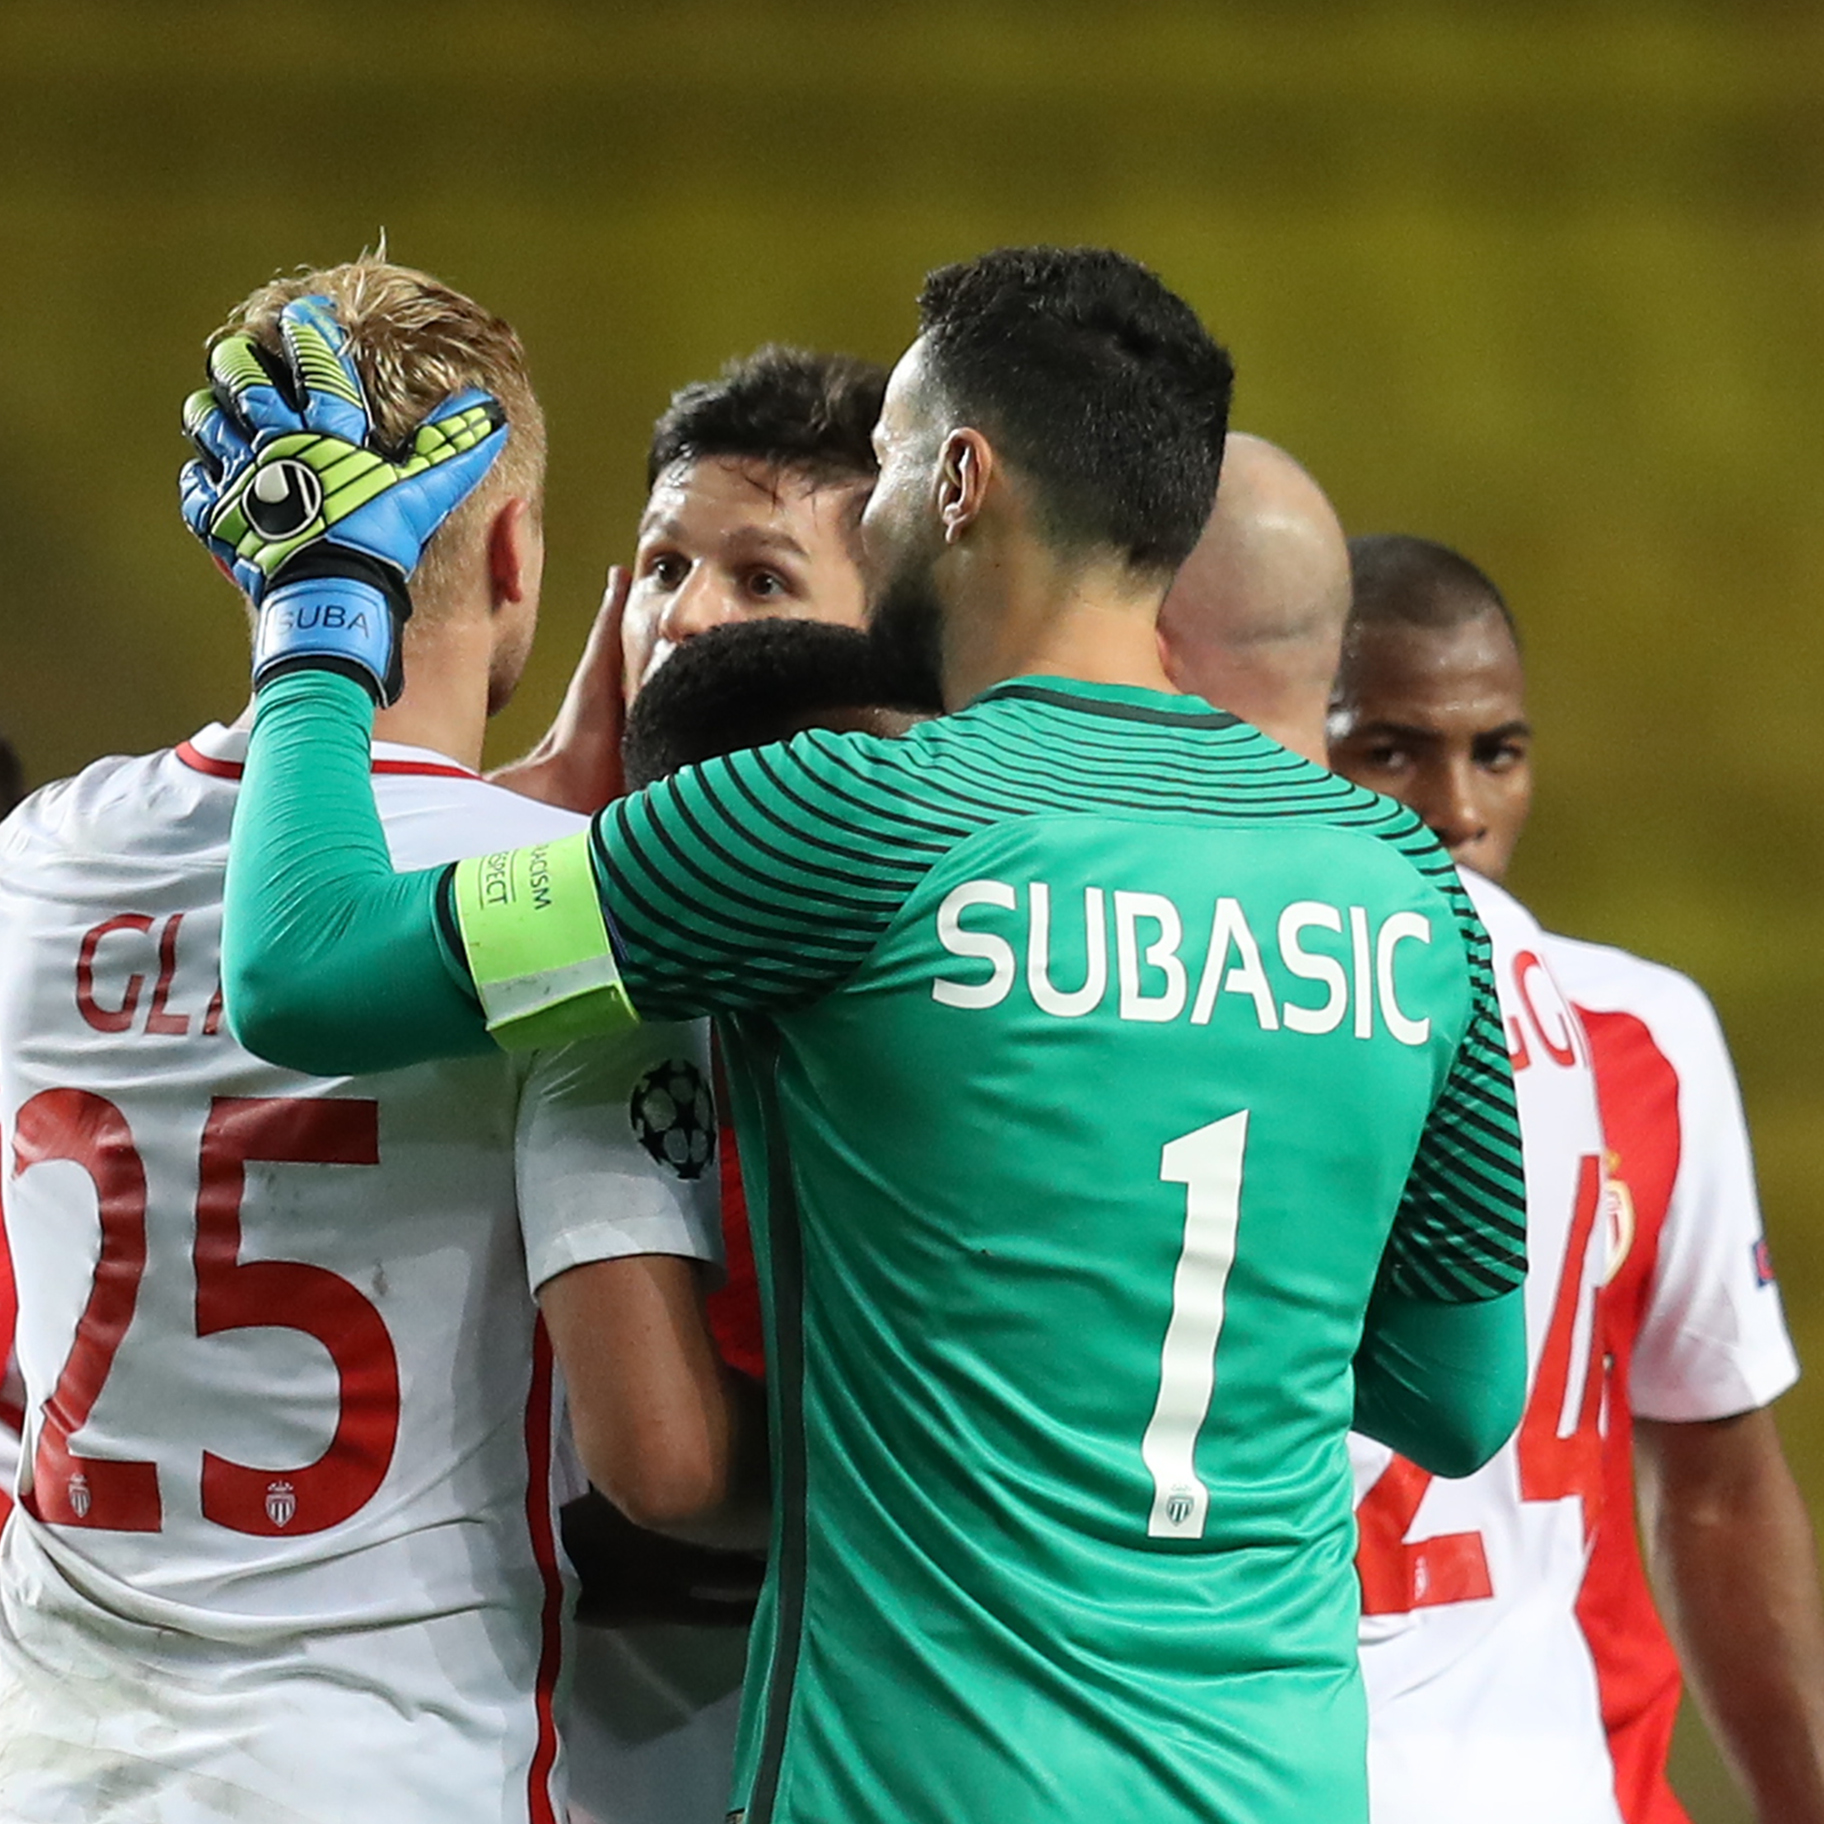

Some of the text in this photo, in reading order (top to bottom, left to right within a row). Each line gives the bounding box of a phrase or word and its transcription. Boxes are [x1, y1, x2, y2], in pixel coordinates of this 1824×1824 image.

[77, 912, 223, 1035] GL
[932, 879, 1433, 1046] SUBASIC
[13, 1087, 400, 1537] 25
[1141, 1108, 1249, 1539] 1
